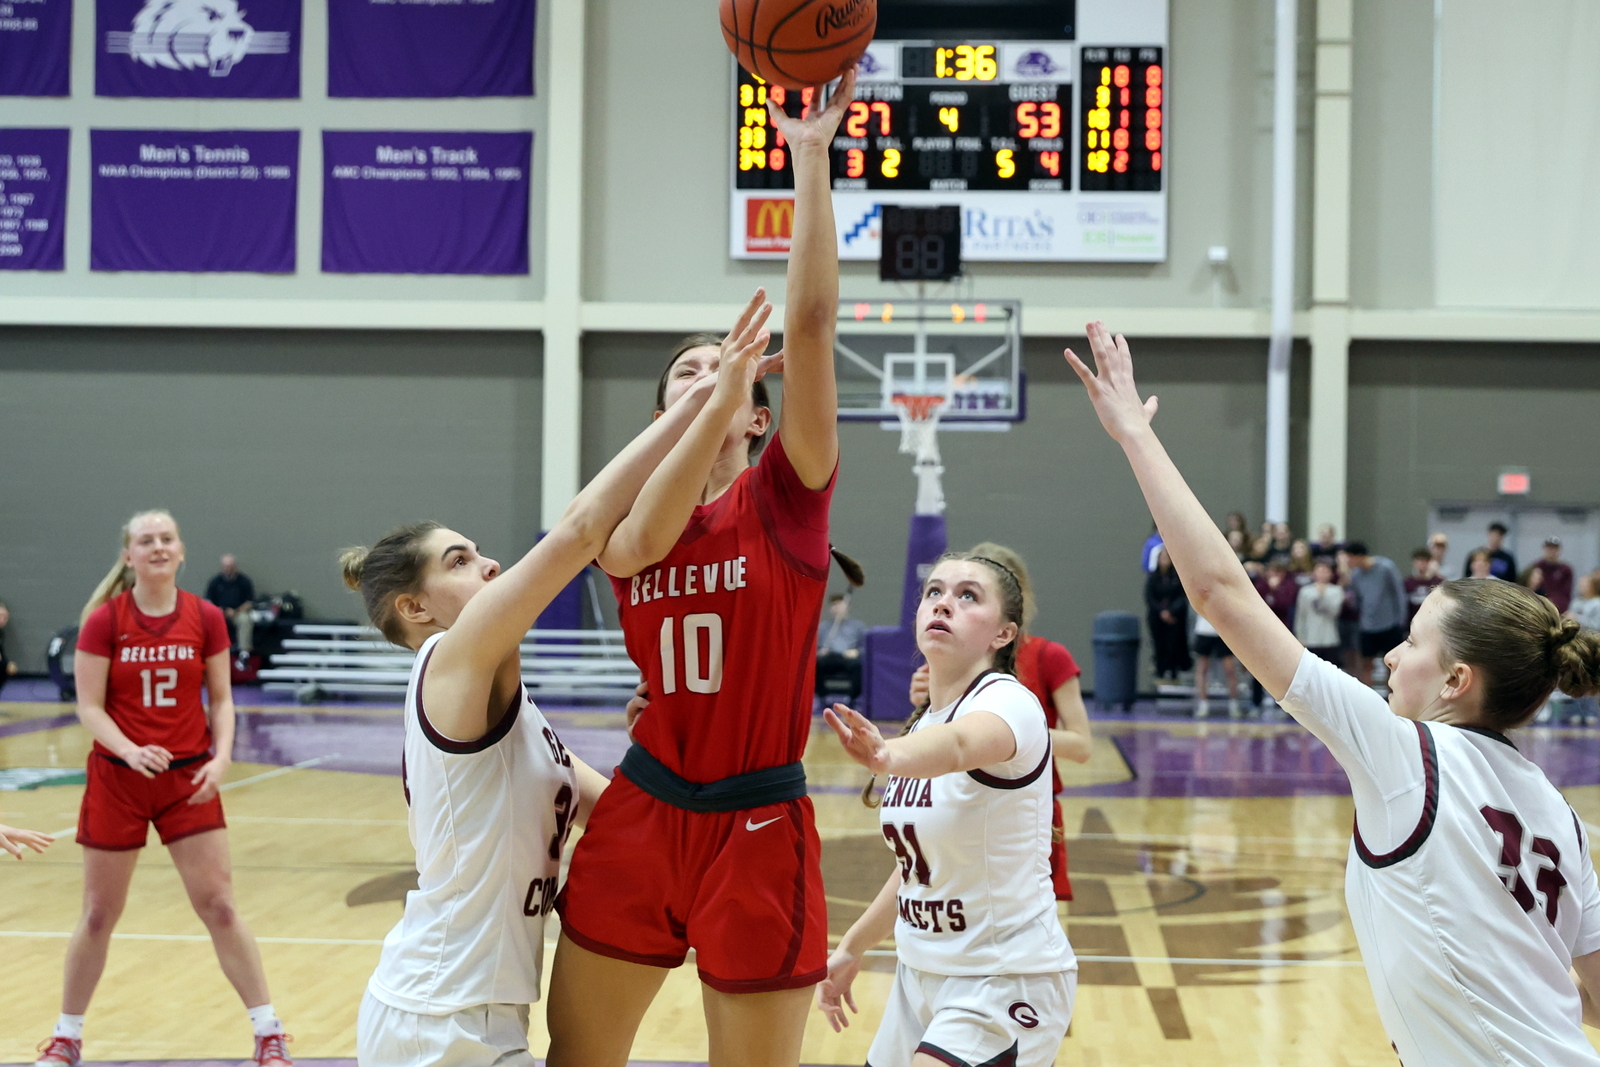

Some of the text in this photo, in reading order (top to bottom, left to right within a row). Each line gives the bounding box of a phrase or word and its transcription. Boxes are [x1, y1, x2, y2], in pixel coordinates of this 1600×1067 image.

[936, 45, 997, 81] 1:36
[1009, 84, 1058, 102] GUEST
[847, 101, 891, 138] 27
[939, 107, 958, 132] 4
[1016, 101, 1061, 138] 53
[139, 145, 250, 163] Men's Tennis
[376, 146, 479, 165] Men's Track
[846, 148, 864, 178] 3
[881, 148, 901, 178] 2
[995, 148, 1015, 178] 5
[1040, 150, 1060, 177] 4
[129, 164, 193, 181] Champions
[631, 556, 747, 606] BELLEVUE
[120, 645, 195, 662] BELLEVUE
[660, 613, 723, 695] 10
[140, 668, 178, 707] 12
[882, 822, 932, 887] 31
[1007, 1000, 1040, 1029] G
